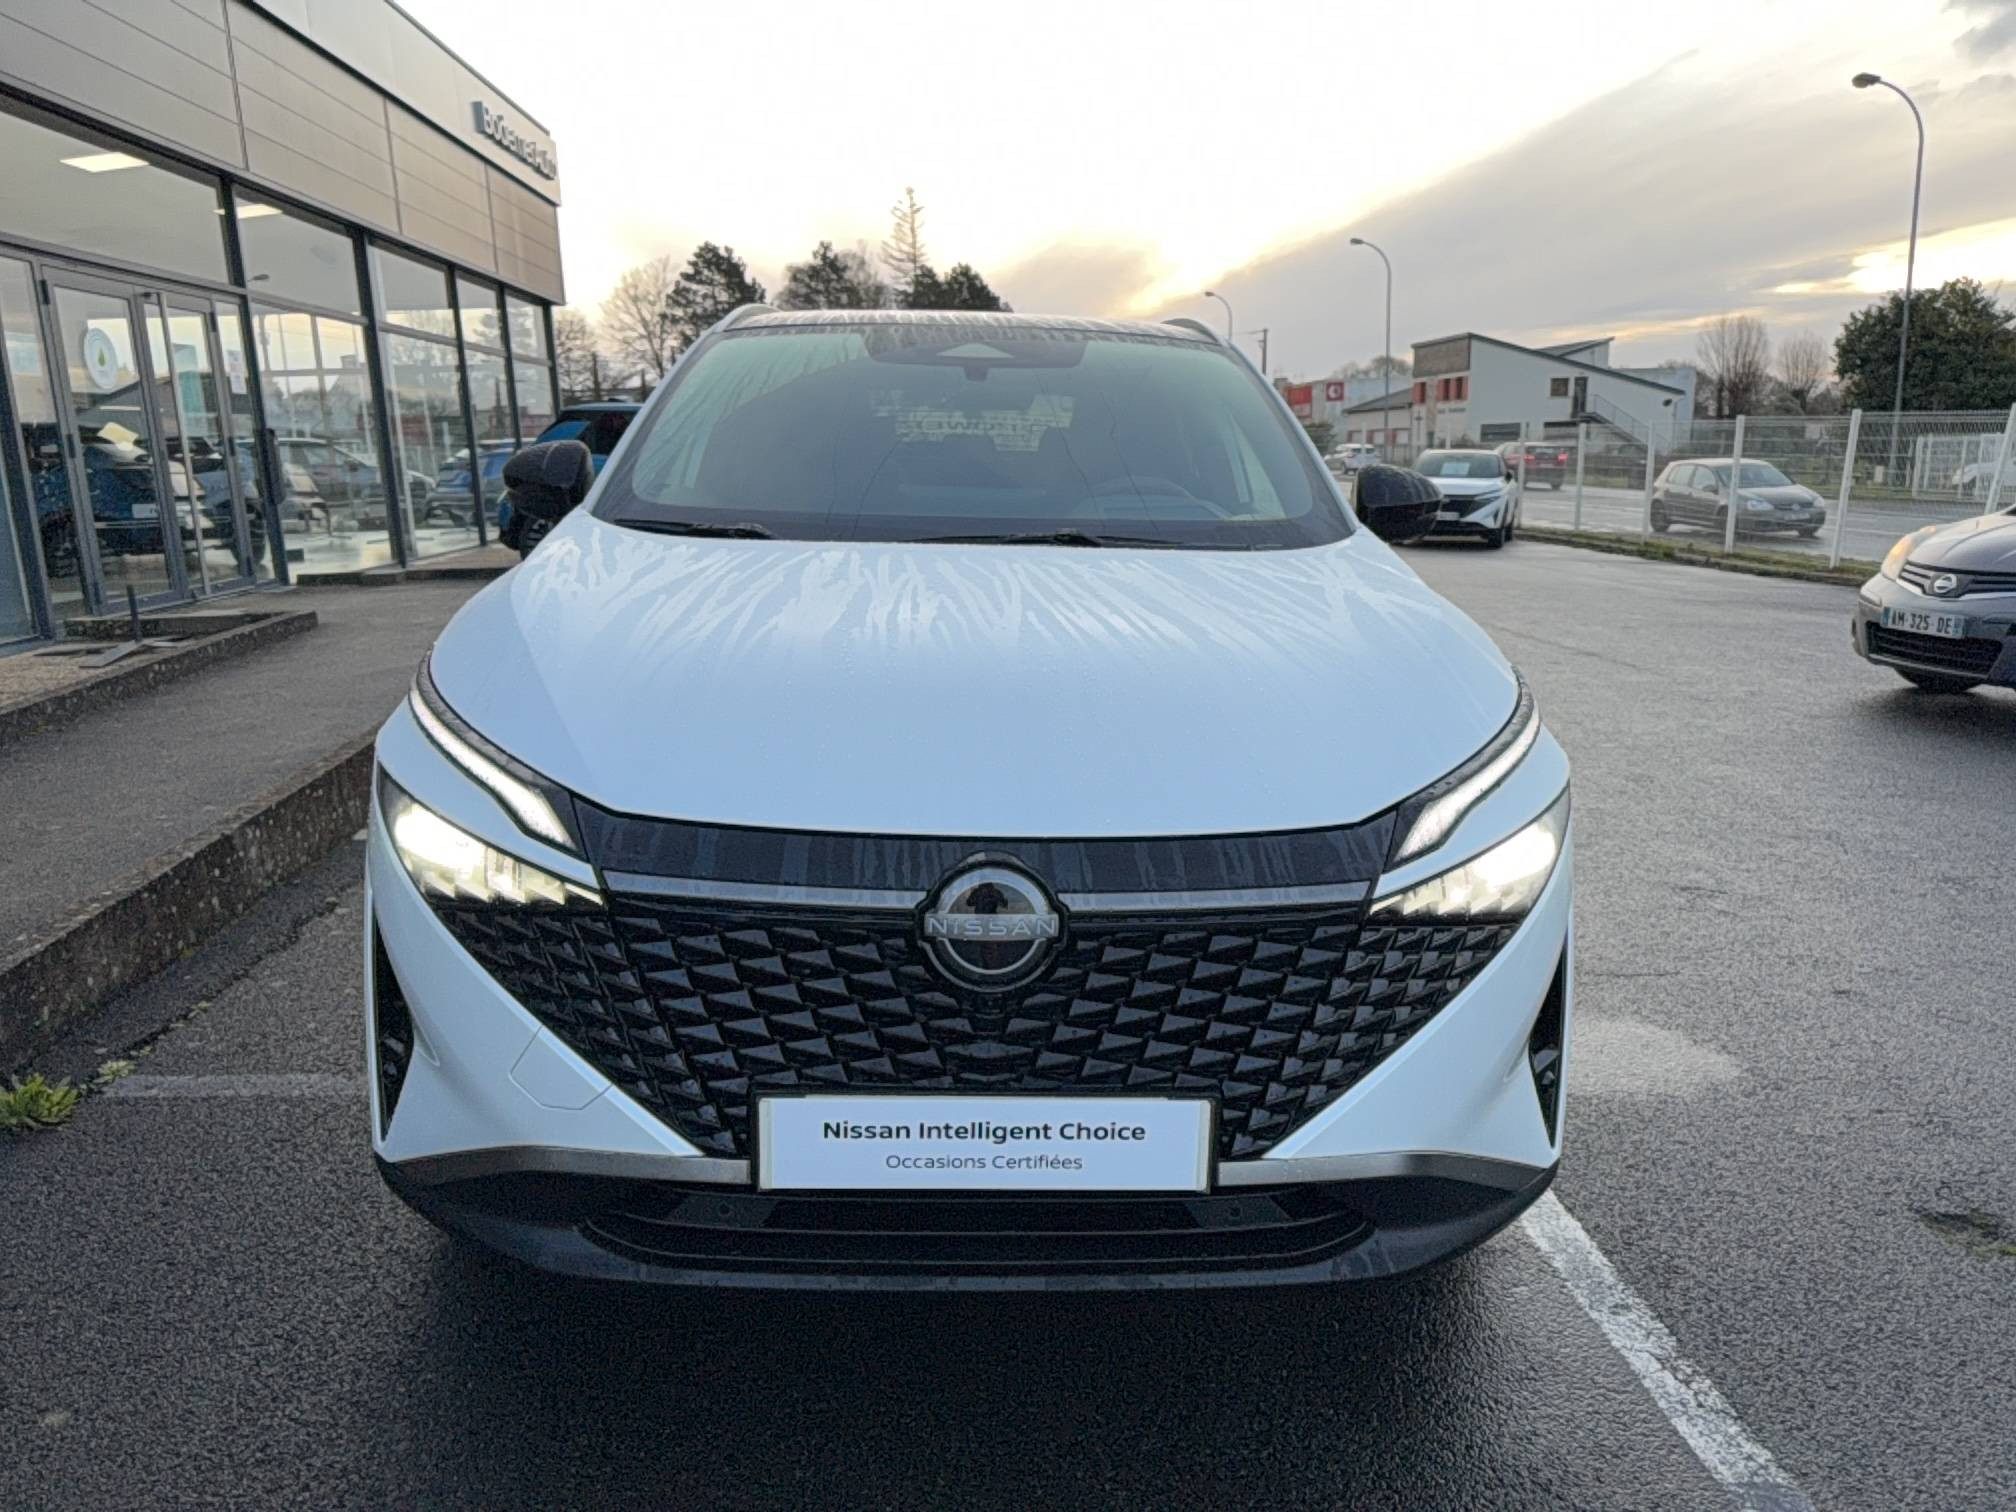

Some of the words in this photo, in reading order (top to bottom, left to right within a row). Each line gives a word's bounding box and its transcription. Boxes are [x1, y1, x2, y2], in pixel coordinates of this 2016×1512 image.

[928, 917, 1055, 936] NISSAN
[823, 1120, 911, 1139] Nissan
[919, 1121, 1053, 1145] Intelligent
[1059, 1121, 1146, 1141] Choice
[885, 1154, 987, 1169] Occasions
[991, 1154, 1083, 1170] Certifiées
